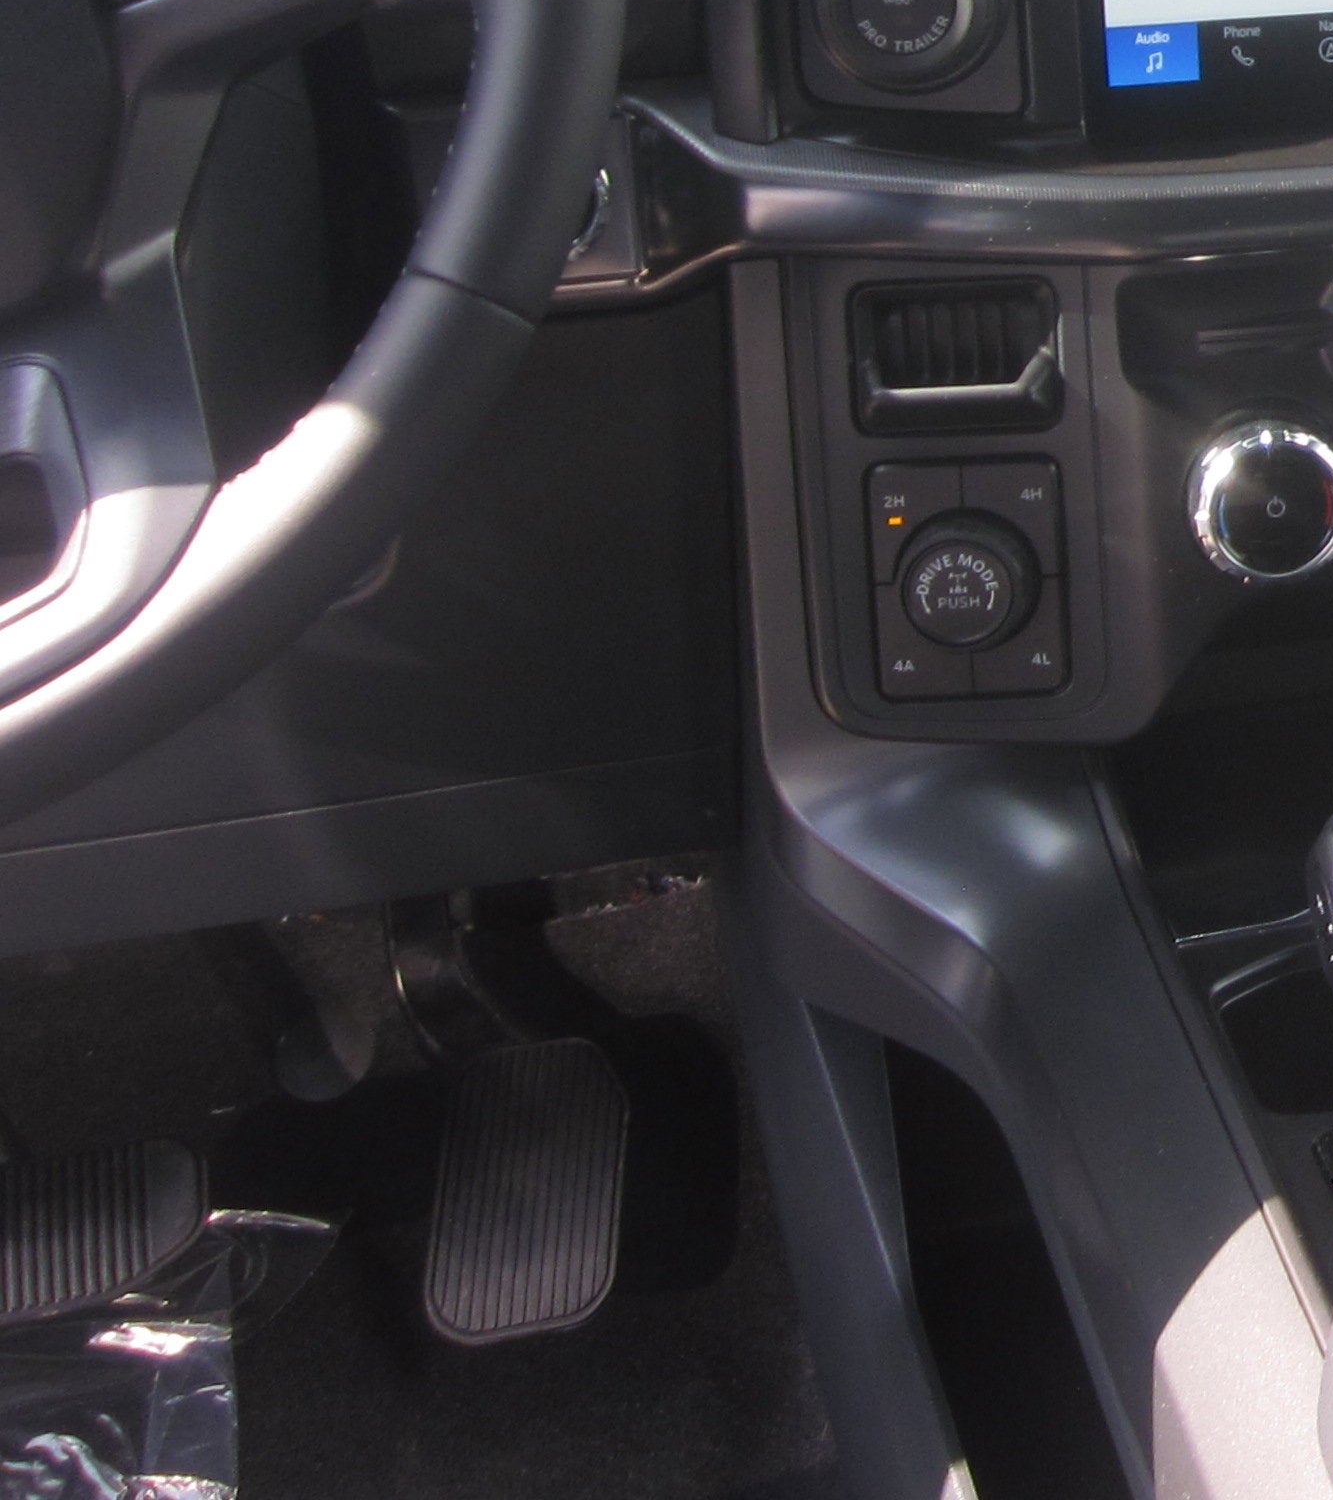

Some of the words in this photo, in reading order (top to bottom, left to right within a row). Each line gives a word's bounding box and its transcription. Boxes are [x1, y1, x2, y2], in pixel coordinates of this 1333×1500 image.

[856, 19, 888, 49] PRO
[893, 15, 951, 53] TRAILER
[1134, 30, 1171, 47] Audio
[1223, 24, 1262, 40] Phone
[1019, 487, 1043, 501] 4H
[883, 495, 906, 509] 2H
[915, 553, 953, 596] DRIVE
[957, 553, 999, 592] MODE
[937, 596, 981, 609] PUSH
[893, 659, 916, 672] 4A
[1031, 652, 1052, 666] 4L
